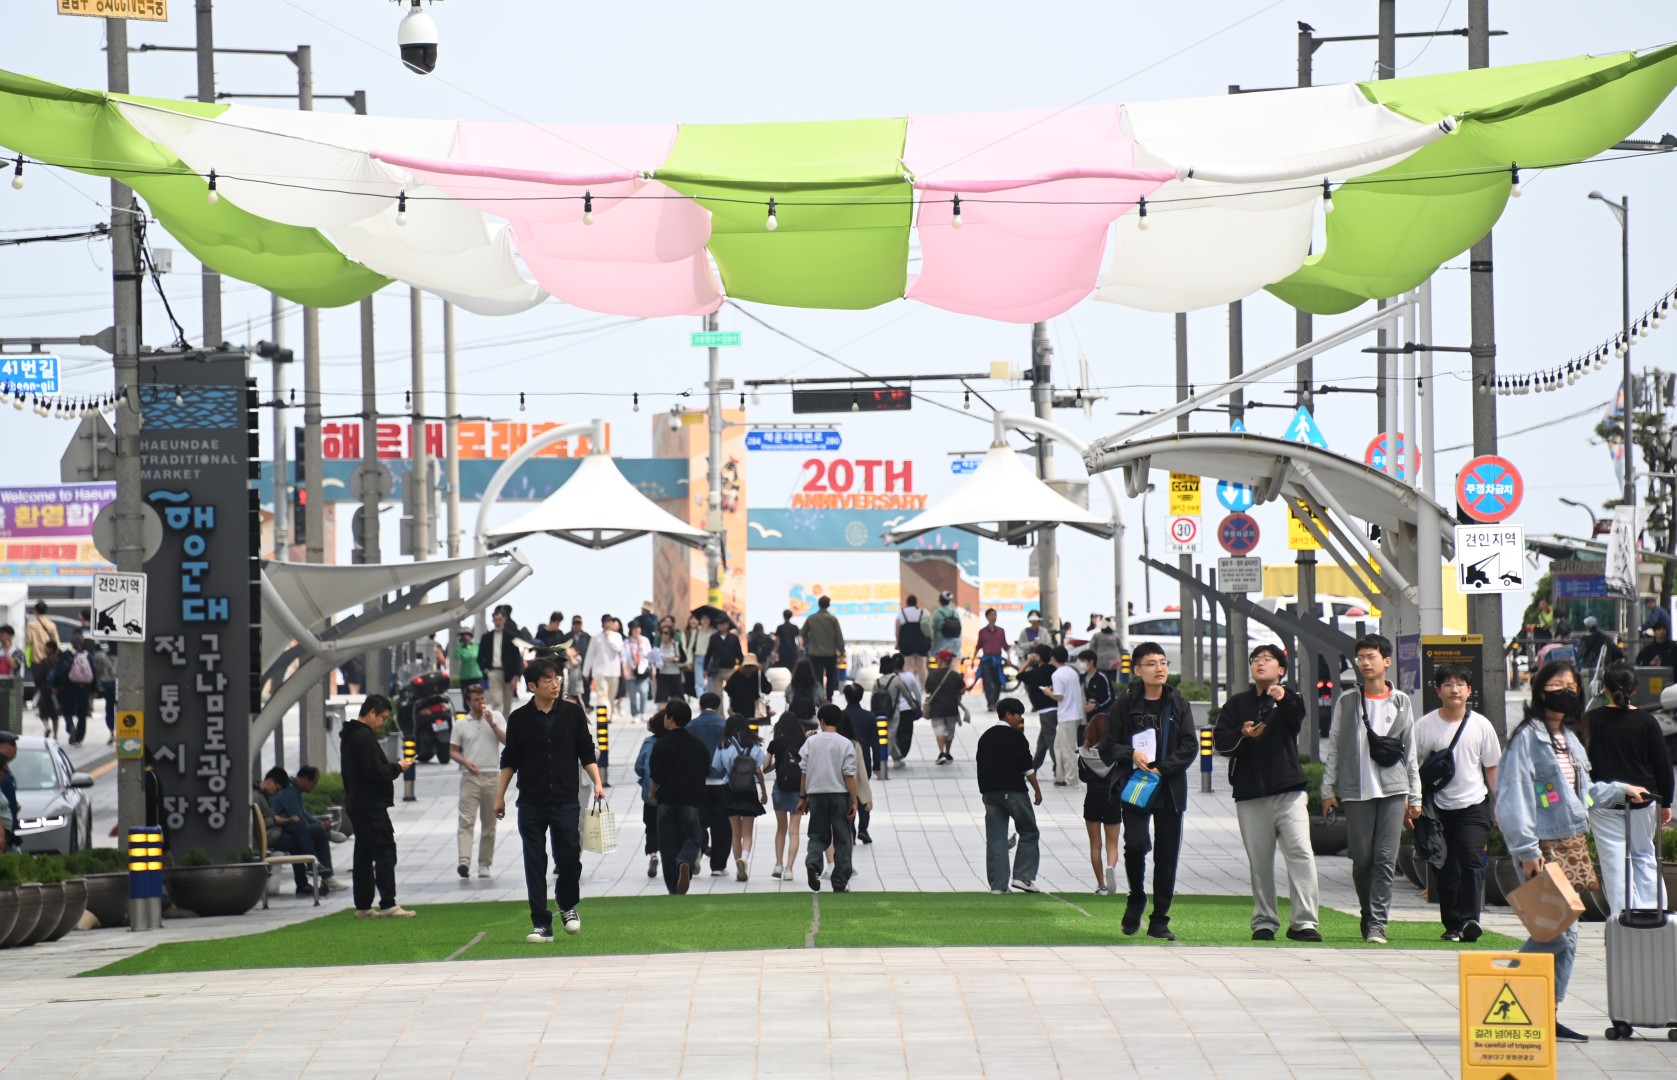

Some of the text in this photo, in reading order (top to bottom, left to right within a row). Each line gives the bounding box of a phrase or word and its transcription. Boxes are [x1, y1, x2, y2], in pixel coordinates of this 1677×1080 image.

[2, 359, 55, 379] 41번길
[140, 439, 220, 451] HAEUNDAE
[140, 453, 240, 465] TRADITIONAL
[140, 468, 202, 480] MARKET
[802, 458, 913, 493] 20TH
[1172, 481, 1199, 491] CCTV
[1465, 483, 1513, 495] 주정차금지
[1, 487, 117, 504] Welcome to Haeun
[791, 493, 929, 510] ANNIVERSARY
[1177, 523, 1191, 537] 30
[1466, 532, 1516, 548] 견인지역
[147, 489, 229, 621] 해운대
[98, 577, 140, 595] 견인지역
[196, 634, 231, 830] 구남로광장
[1475, 1029, 1541, 1040] 걸려 넘어짐 주의
